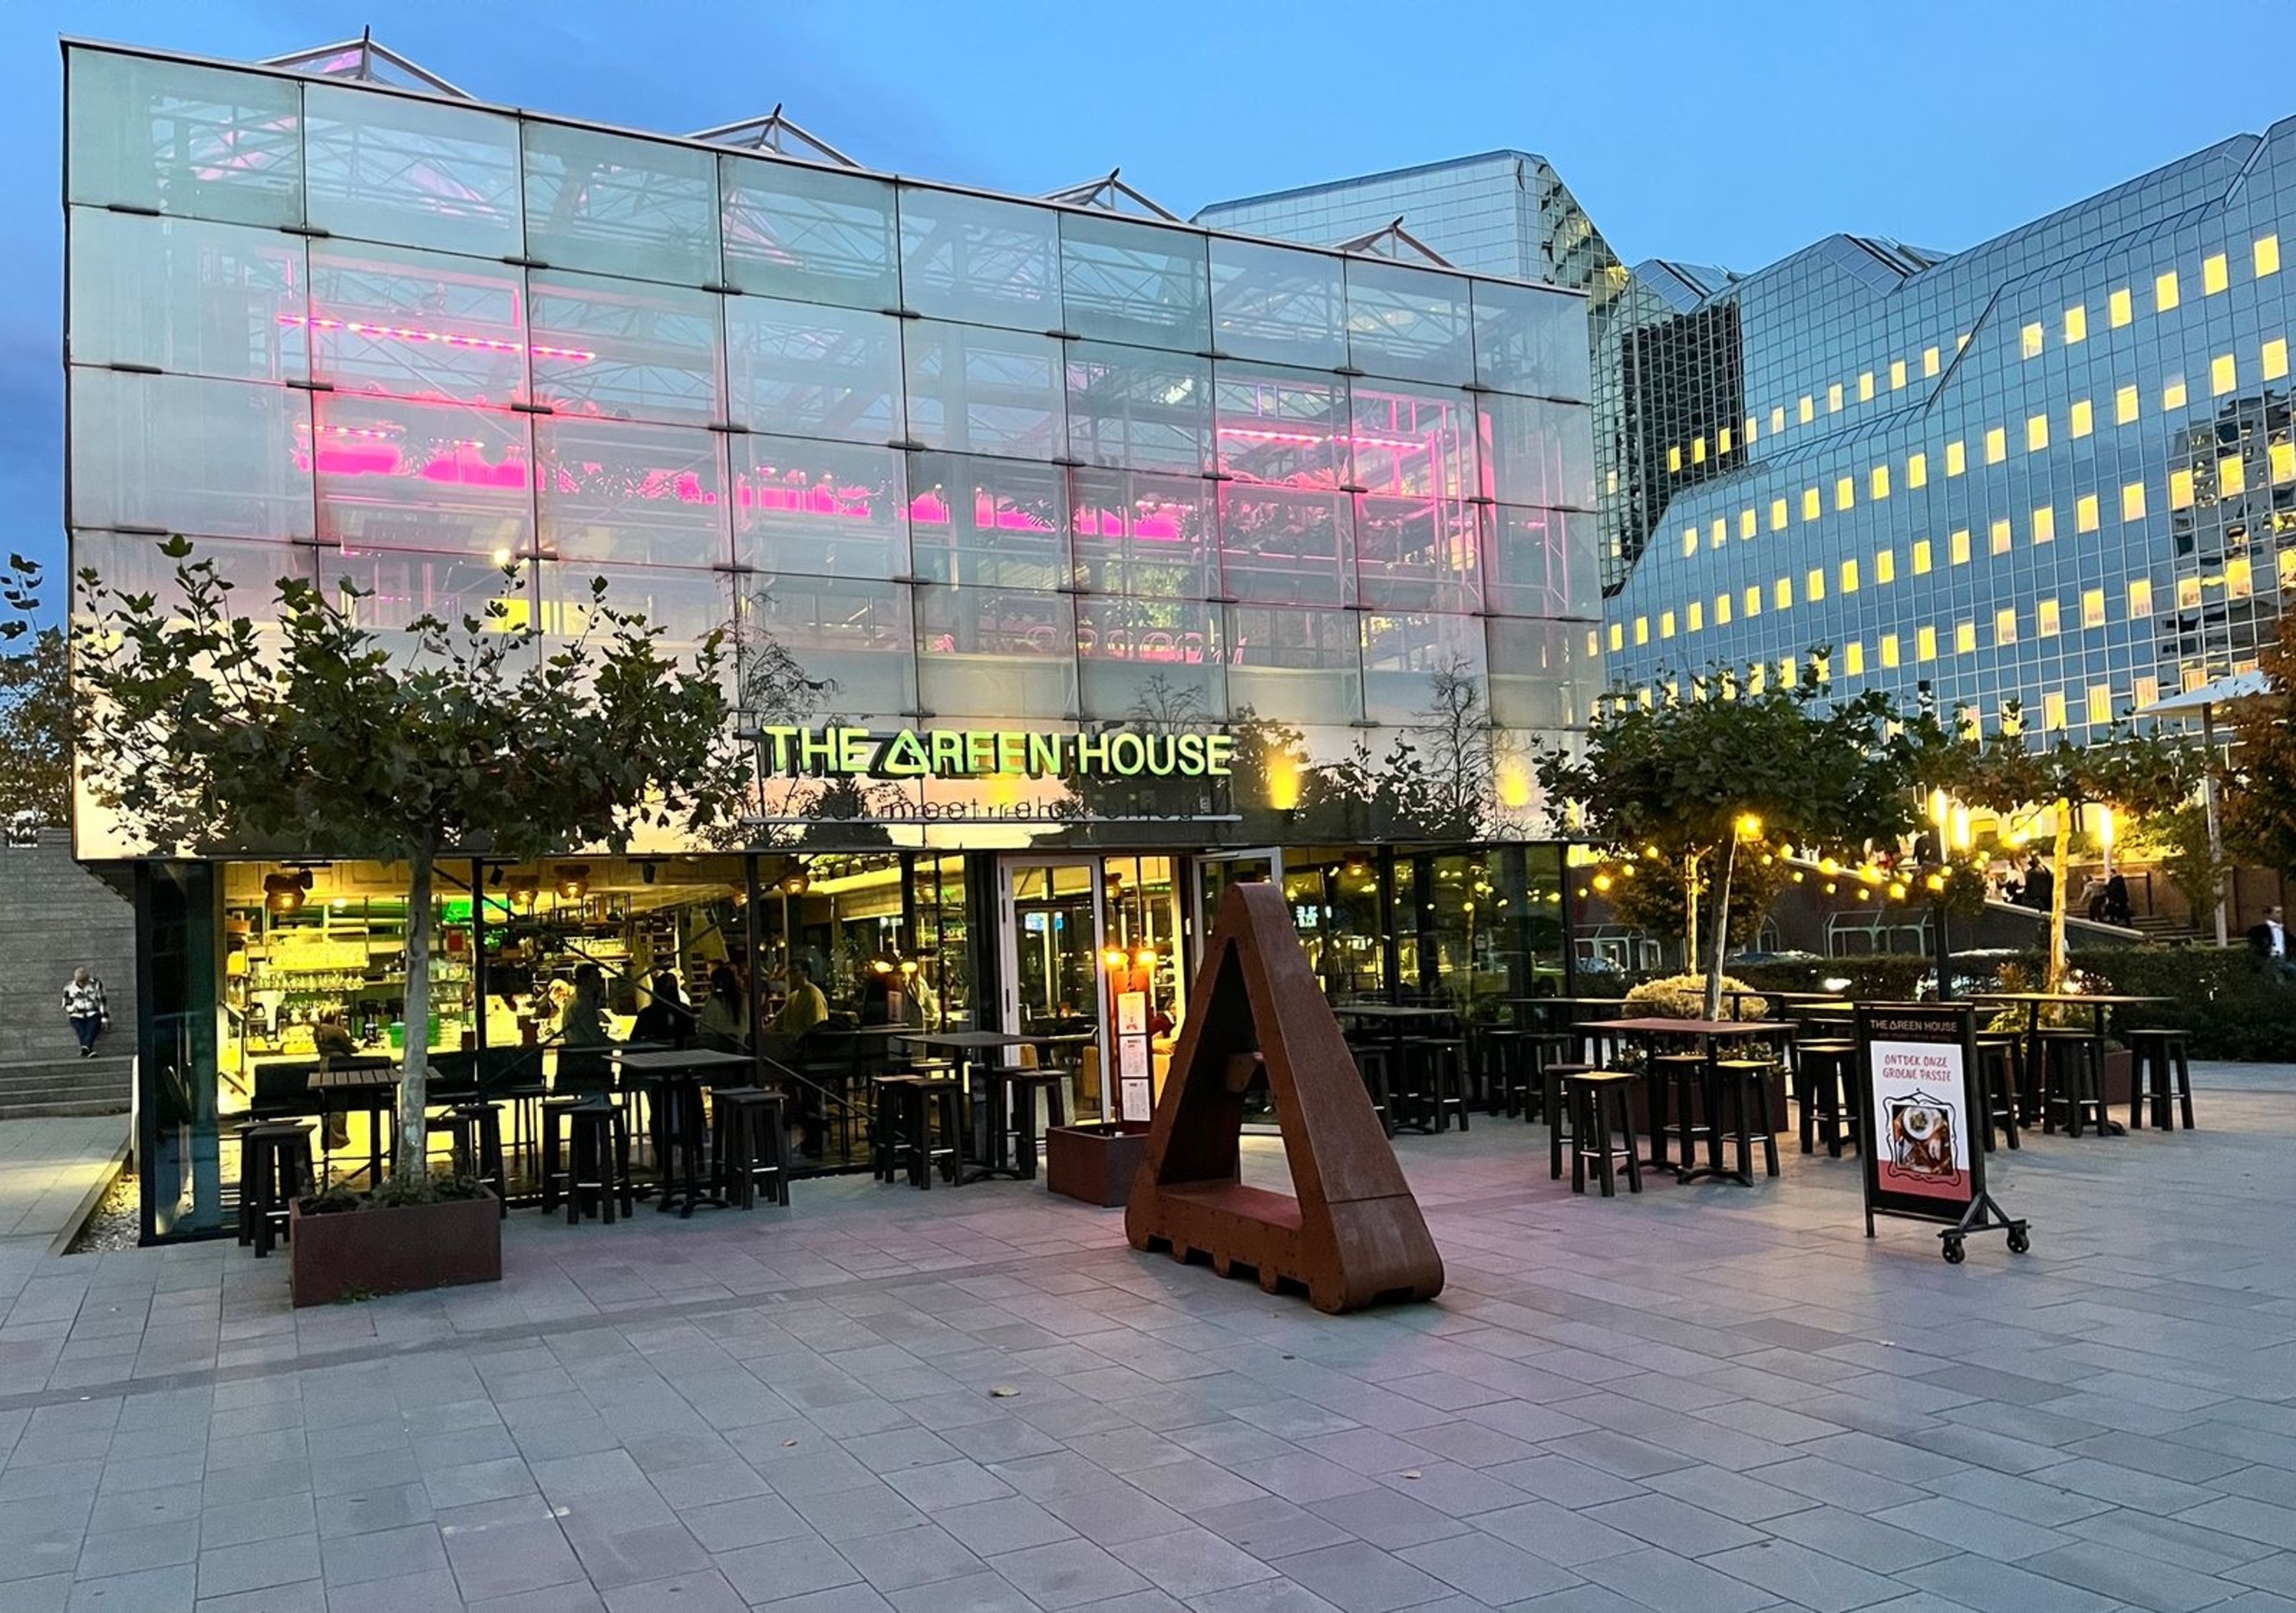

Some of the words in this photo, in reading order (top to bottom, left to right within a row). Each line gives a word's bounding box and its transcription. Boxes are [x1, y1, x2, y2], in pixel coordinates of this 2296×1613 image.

[762, 725, 870, 772] THE
[1079, 733, 1232, 776] HOUSE
[889, 797, 980, 820] meet
[1870, 1019, 1888, 1030] THE
[1923, 1021, 1958, 1032] HOUSE
[1884, 1054, 1921, 1067] ONTDEK
[1923, 1055, 1948, 1068] ONZE
[1883, 1068, 1917, 1080] GROENE
[1920, 1069, 1952, 1082] PASSIE
